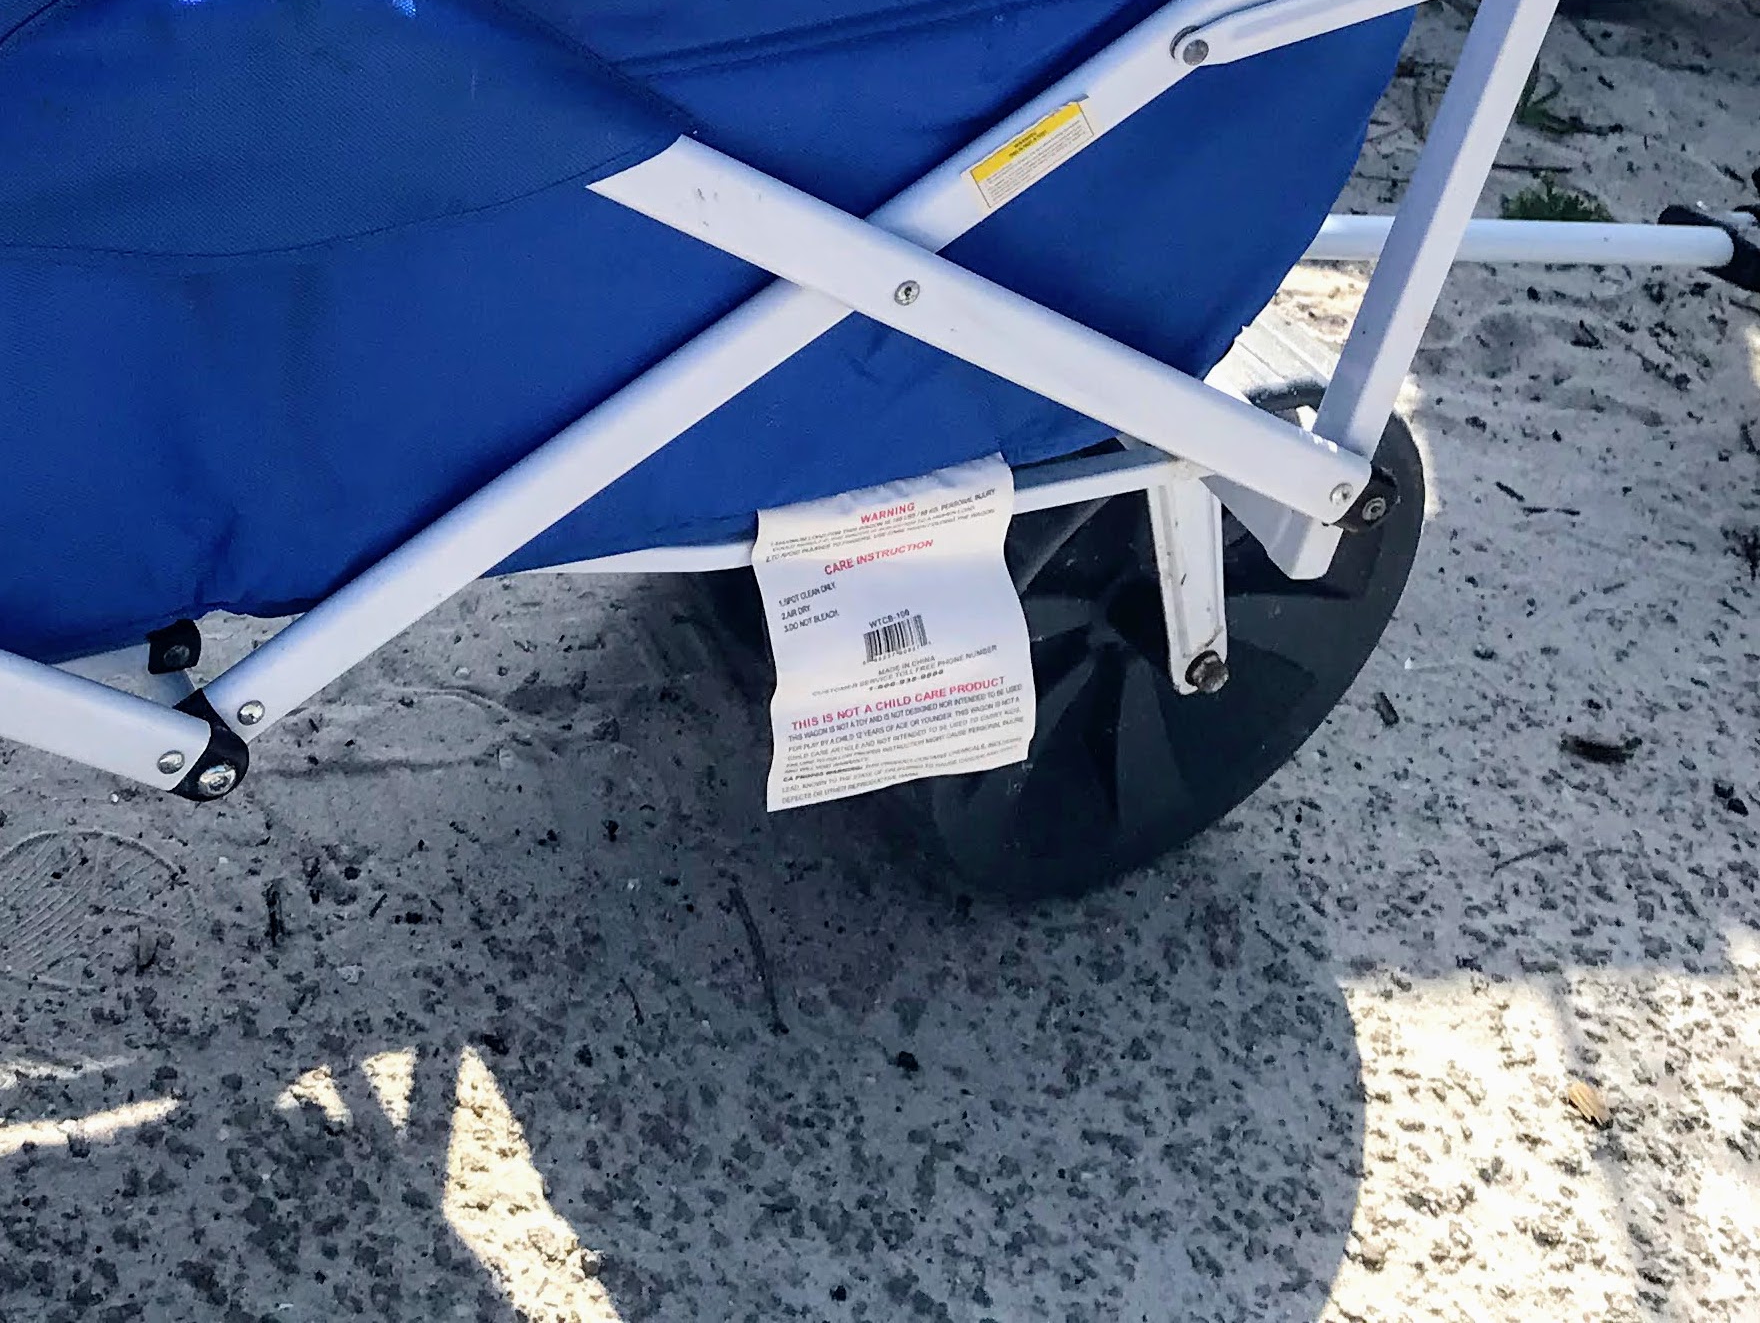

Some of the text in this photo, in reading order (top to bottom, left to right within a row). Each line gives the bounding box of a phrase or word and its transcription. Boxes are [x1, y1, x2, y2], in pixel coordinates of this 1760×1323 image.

[860, 502, 916, 524] WARNING
[823, 557, 854, 575] CARE
[856, 539, 934, 566] INSTRUCTION
[910, 655, 935, 666] CHINA
[964, 644, 998, 659] NUMBER
[791, 716, 819, 730] THIS
[822, 712, 833, 723] IS
[836, 706, 860, 720] NOT
[863, 704, 872, 713] A
[875, 695, 912, 711] CHILD
[913, 687, 946, 703] CARE
[948, 675, 1006, 696] PRODUCT
[863, 726, 884, 736] YEARS
